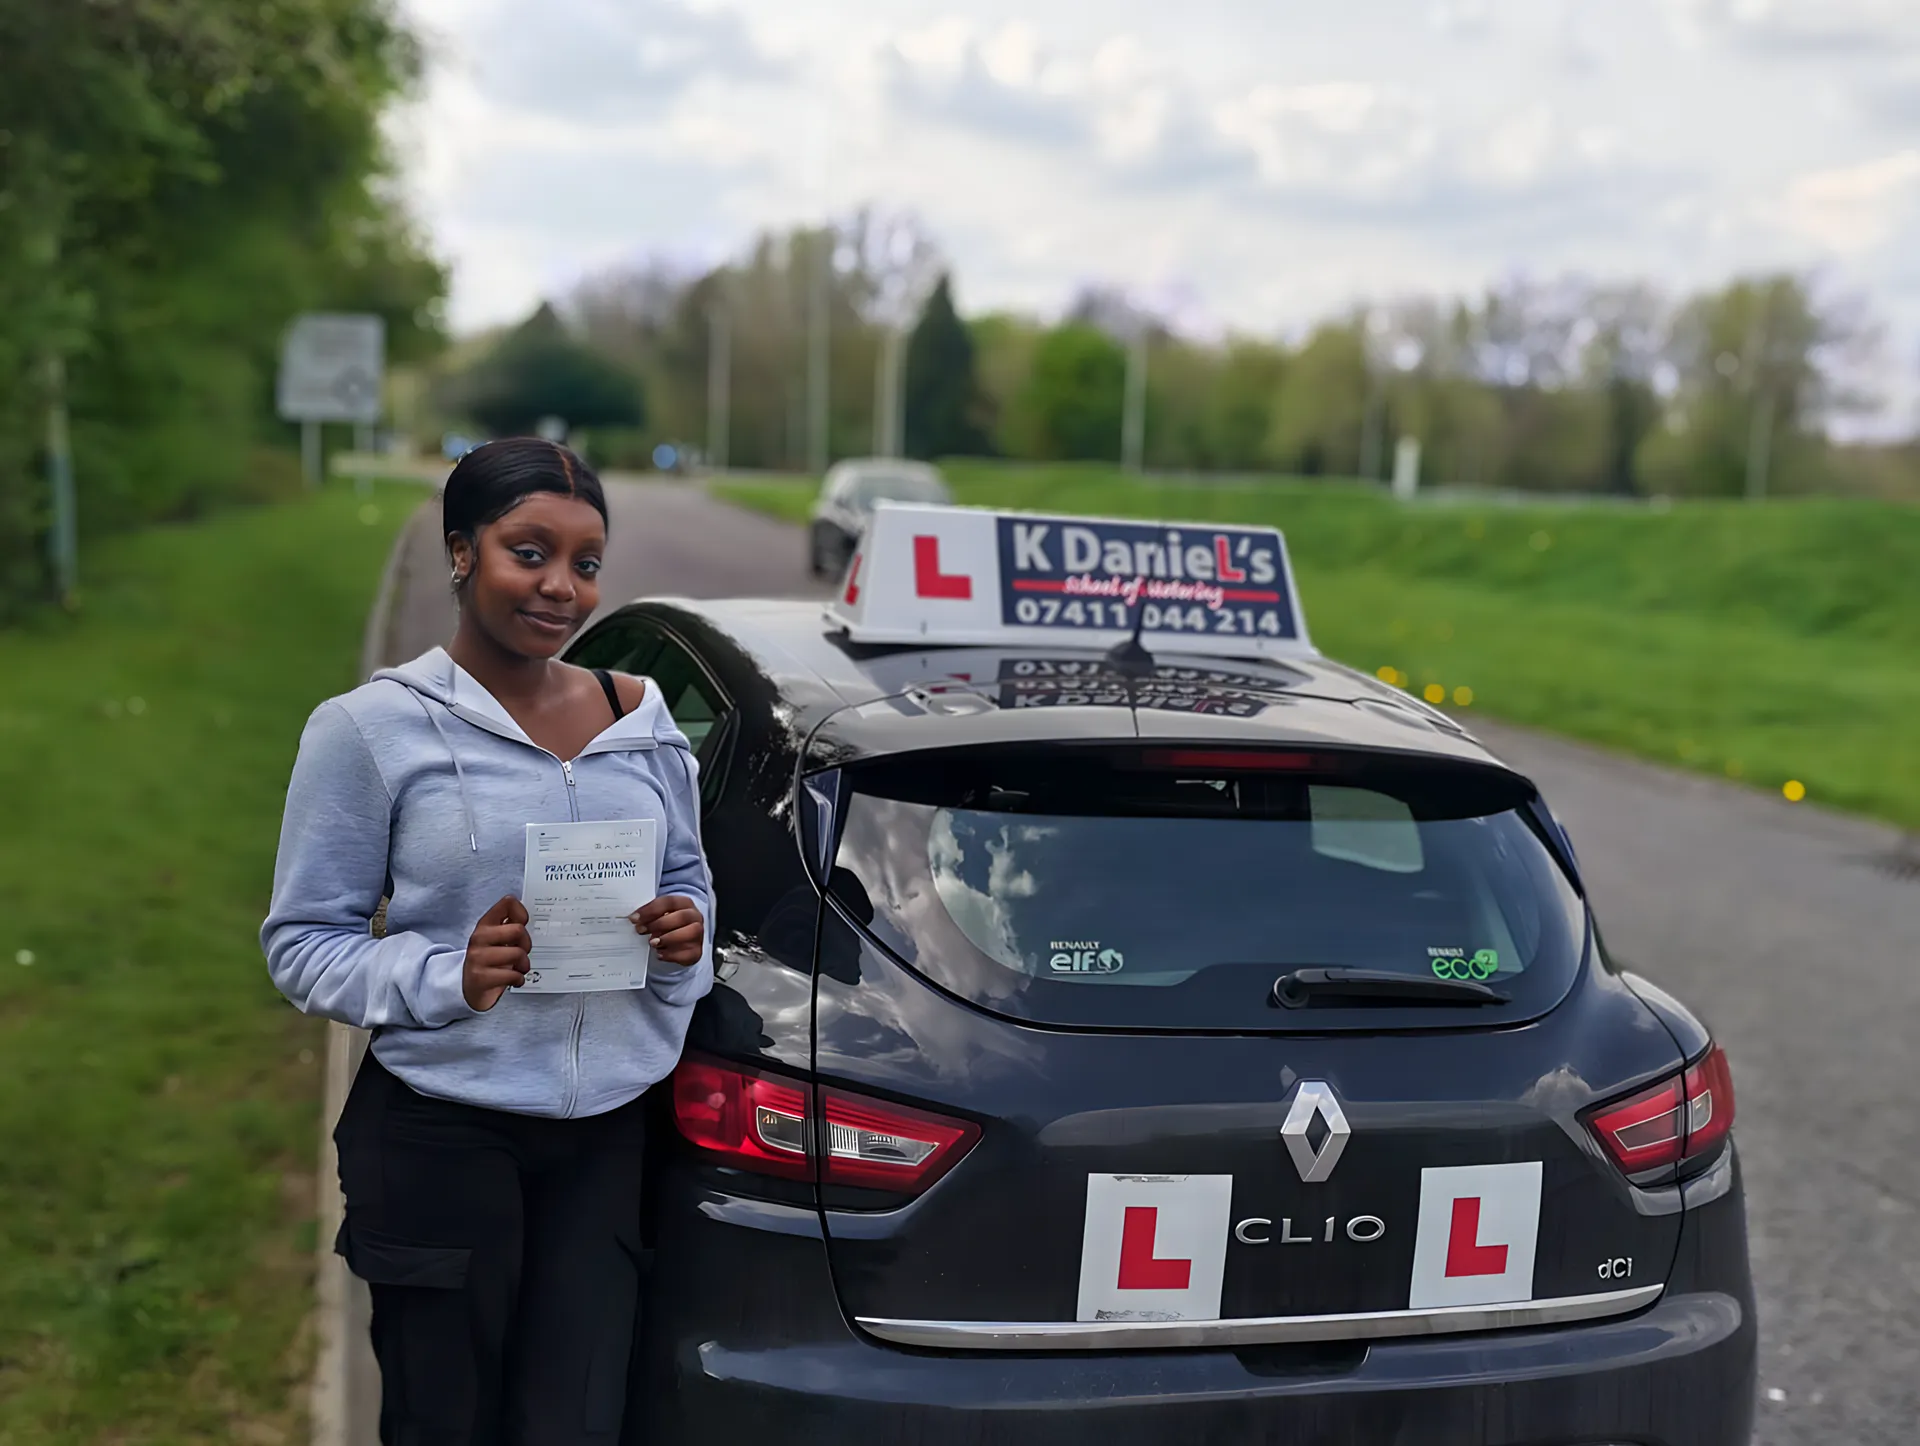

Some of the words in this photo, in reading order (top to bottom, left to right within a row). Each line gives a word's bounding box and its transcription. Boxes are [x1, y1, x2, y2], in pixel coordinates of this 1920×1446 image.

[913, 534, 973, 600] L
[1013, 523, 1053, 572] K
[1062, 526, 1276, 584] DanieL's
[1015, 598, 1128, 627] 07411
[1142, 603, 1207, 631] 044
[1213, 608, 1281, 635] 214
[1050, 941, 1100, 949] RENAULT
[1050, 951, 1096, 971] elf
[1117, 1206, 1192, 1289] L
[1235, 1215, 1386, 1244] CLIO
[1444, 1197, 1509, 1277] L
